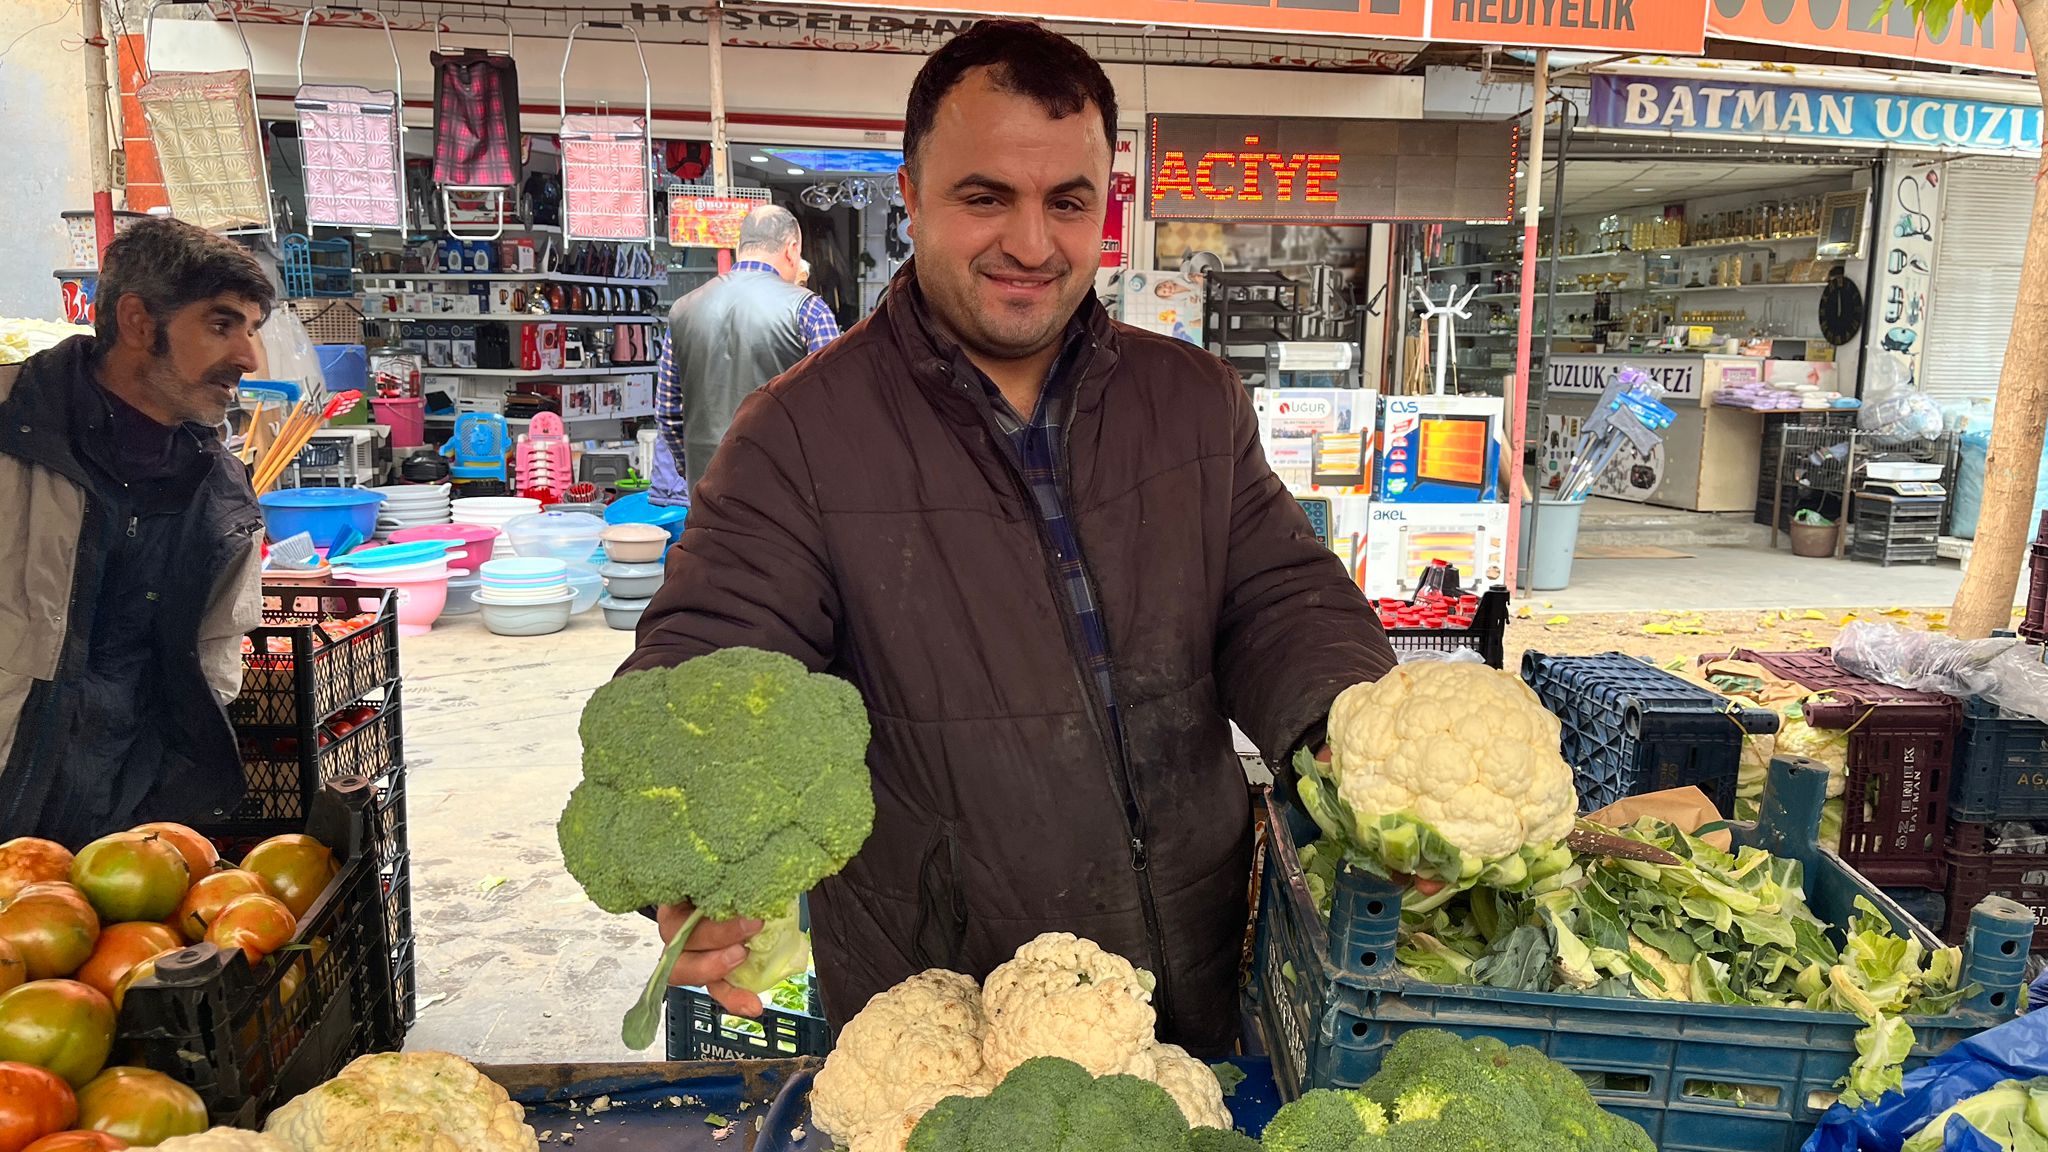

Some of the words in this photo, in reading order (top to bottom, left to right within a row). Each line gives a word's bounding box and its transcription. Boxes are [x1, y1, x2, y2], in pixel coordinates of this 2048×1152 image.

[1624, 82, 1855, 135] BATMAN
[1875, 98, 2043, 147] UCUZL
[1115, 141, 1131, 152] UK
[1152, 136, 1341, 201] ACİYE
[1391, 402, 1418, 413] CVS
[1908, 771, 1921, 832] BATMAN
[2029, 906, 2047, 917] ET
